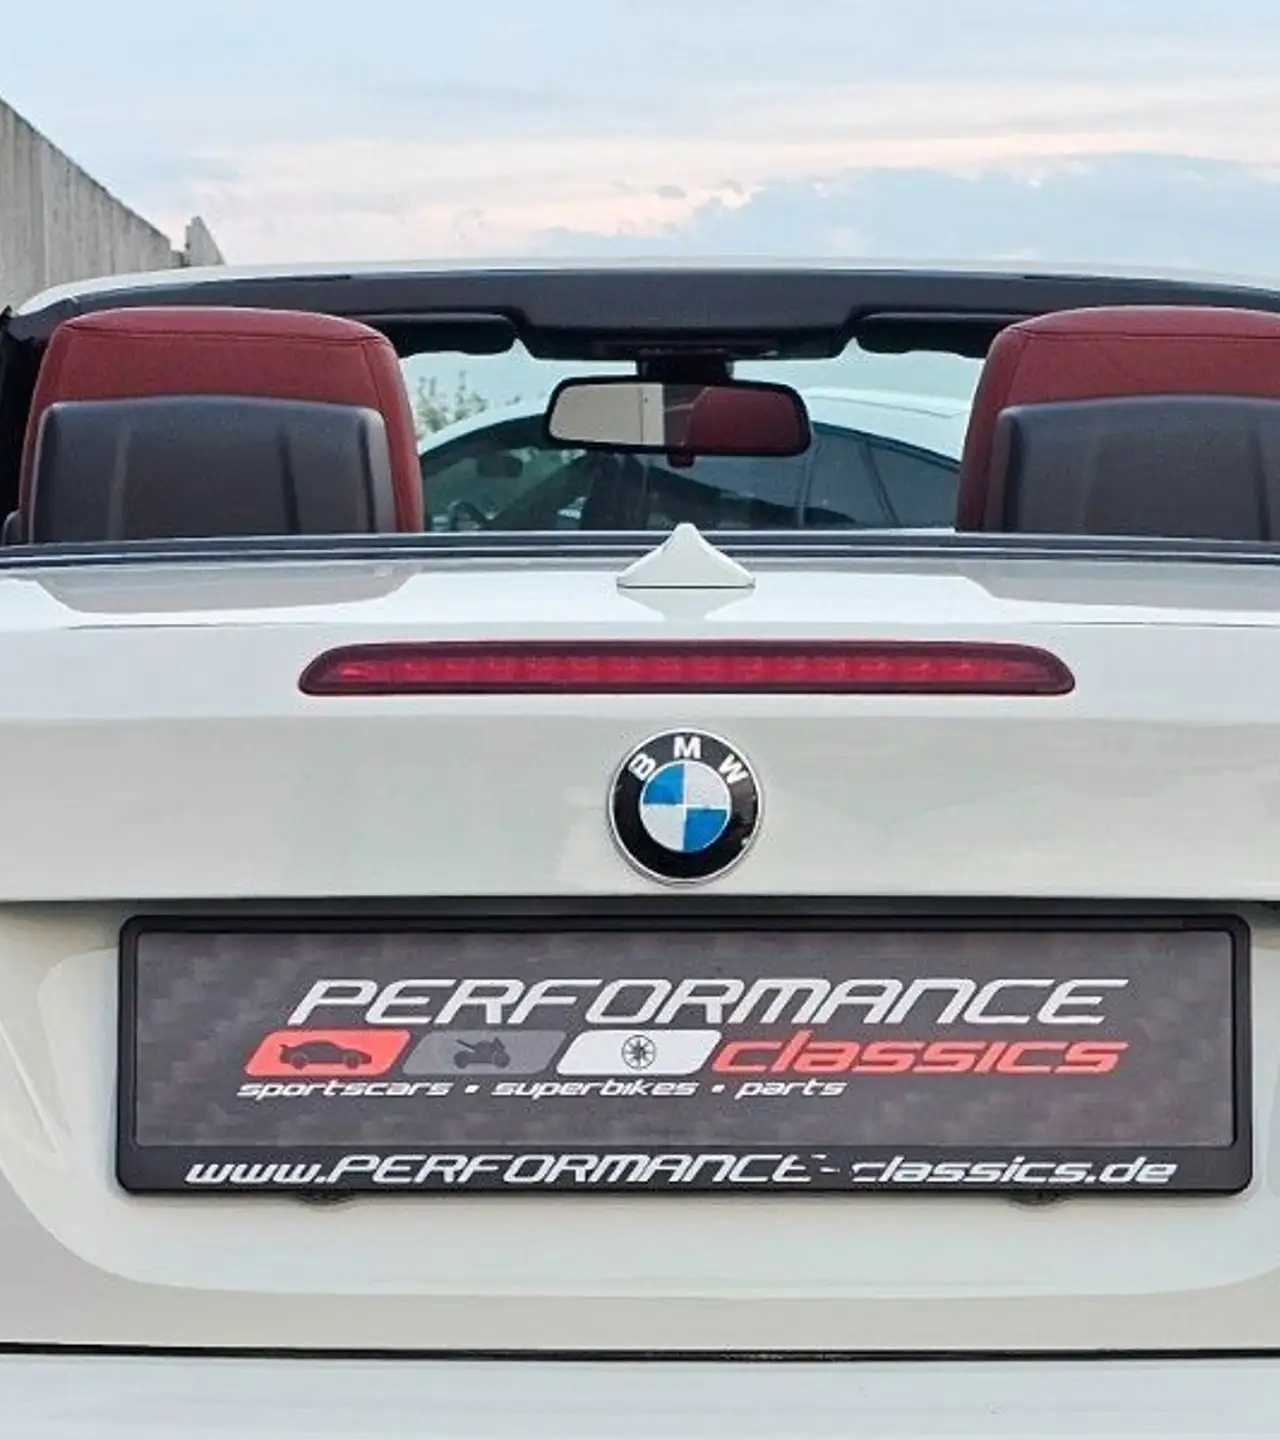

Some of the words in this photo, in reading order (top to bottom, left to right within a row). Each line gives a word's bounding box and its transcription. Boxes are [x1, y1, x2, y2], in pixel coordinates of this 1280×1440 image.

[628, 736, 749, 784] BMW
[287, 978, 1130, 1026] PERFORMANCE
[712, 1028, 1130, 1075] classics
[236, 1078, 451, 1101] sportscars
[490, 1078, 701, 1101] superbikes
[733, 1079, 848, 1101] parts
